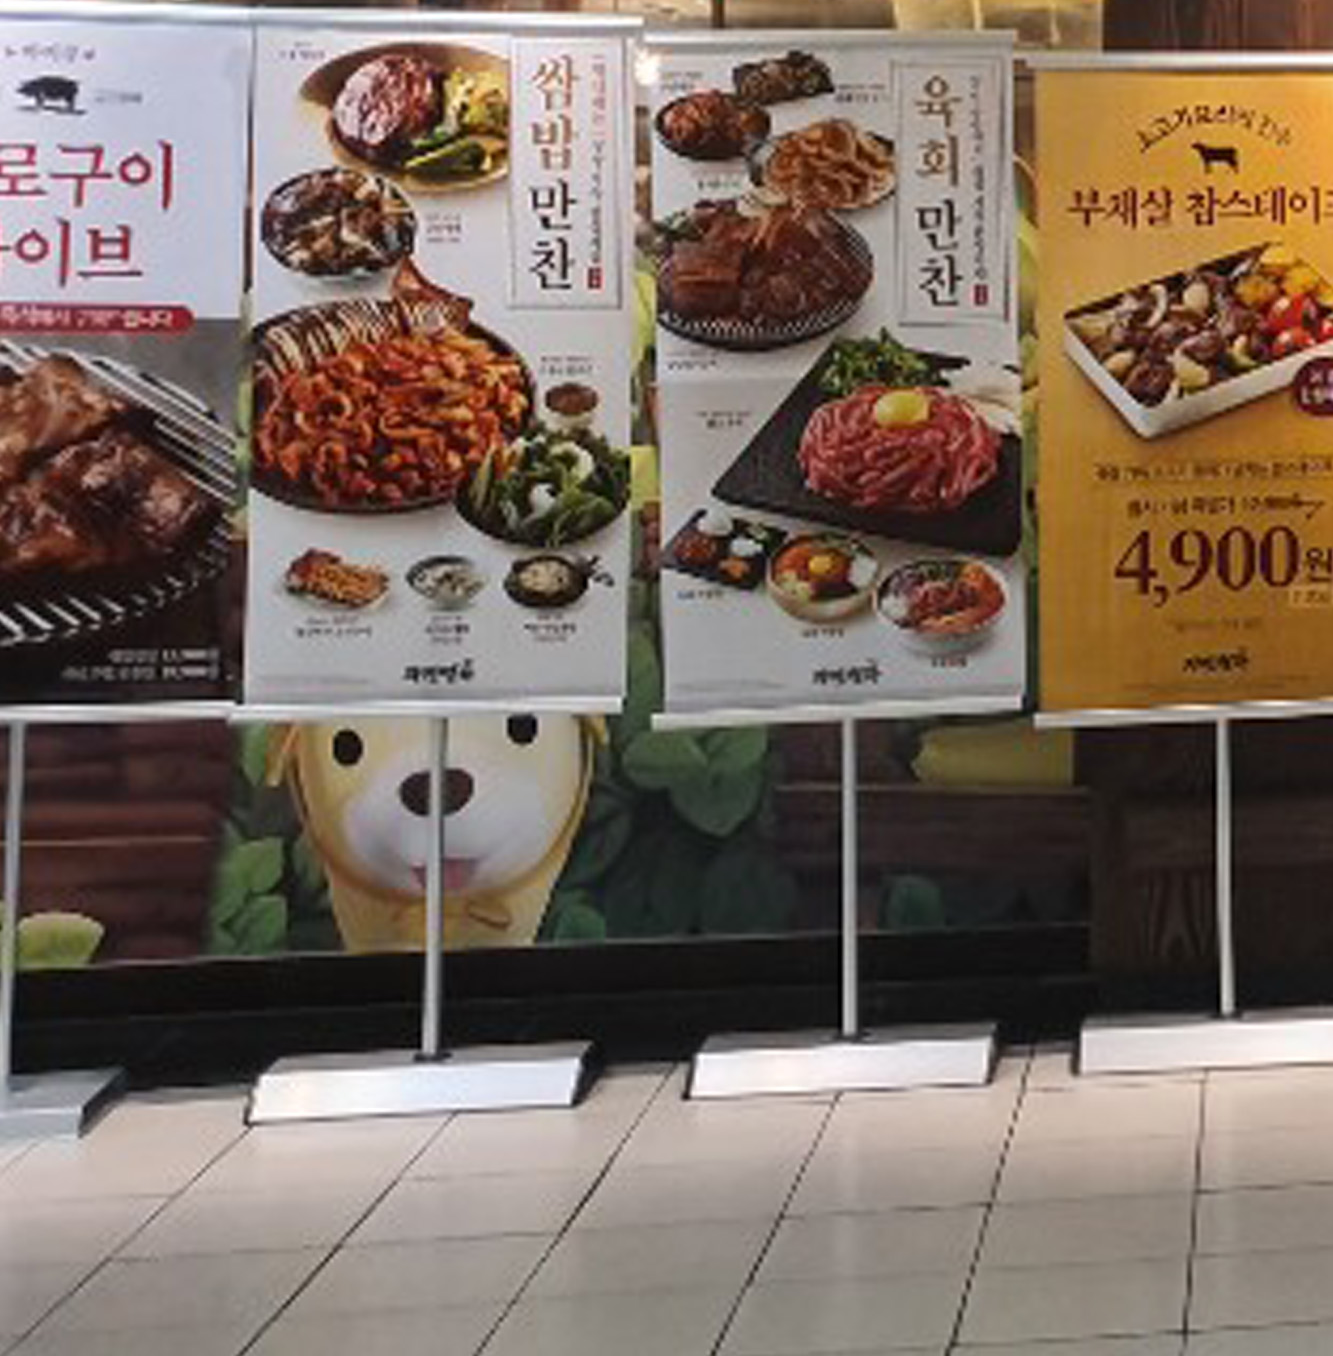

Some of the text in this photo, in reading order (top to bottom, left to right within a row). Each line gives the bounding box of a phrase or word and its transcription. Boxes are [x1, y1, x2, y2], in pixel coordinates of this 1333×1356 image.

[1066, 185, 1173, 230] 부채살
[0, 217, 143, 289] 이브
[1114, 525, 1333, 608] 4,900원
